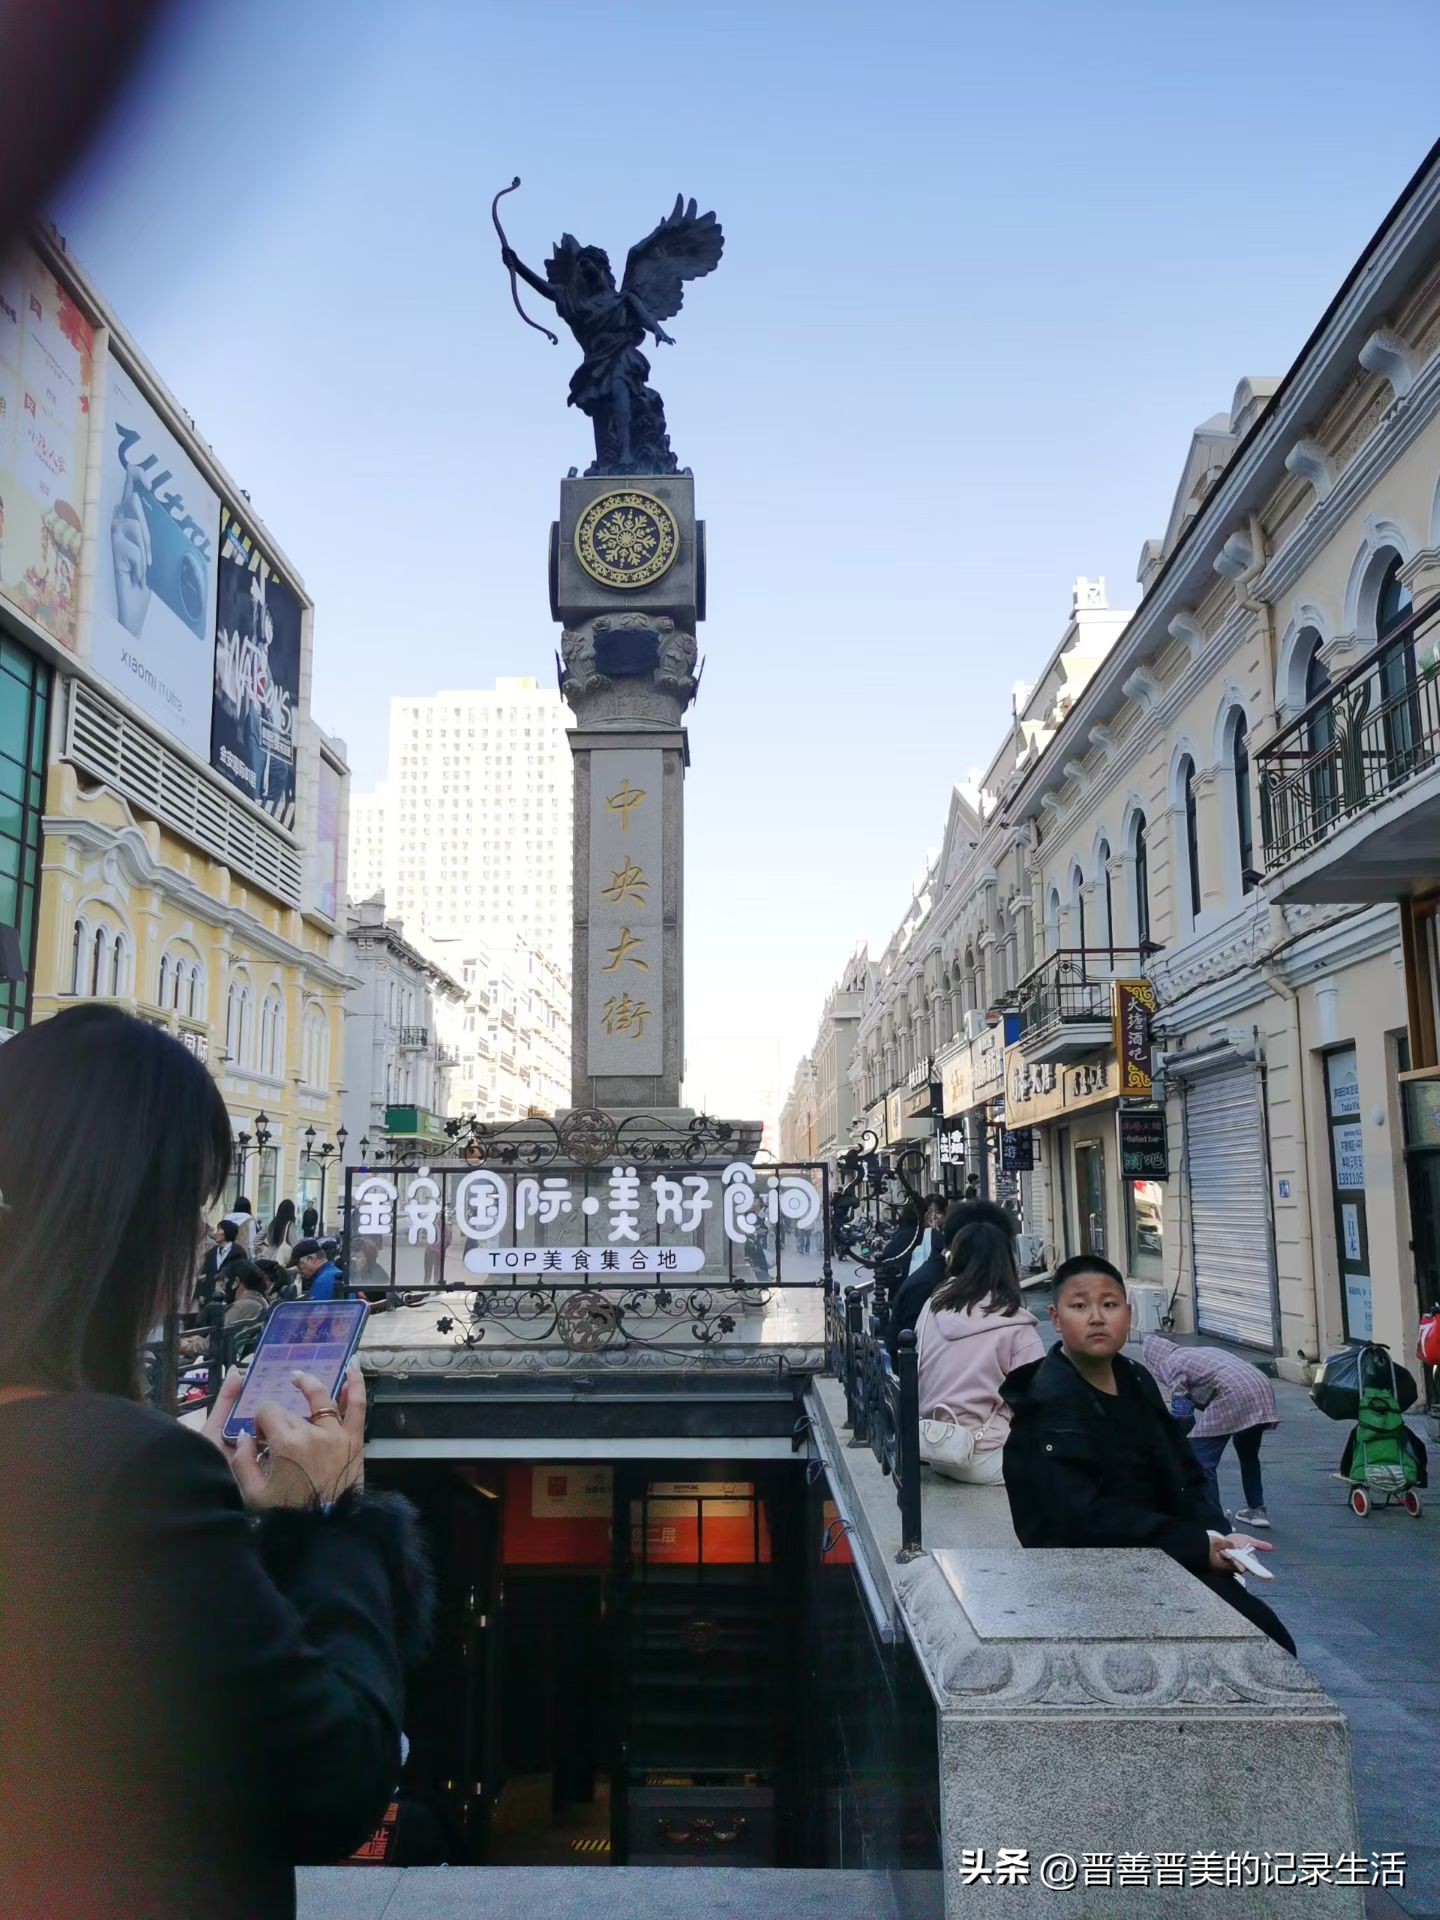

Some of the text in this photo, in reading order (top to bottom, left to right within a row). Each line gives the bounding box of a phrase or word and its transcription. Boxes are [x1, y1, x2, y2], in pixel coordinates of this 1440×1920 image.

[601, 779, 651, 1040] 中央大街
[1127, 996, 1148, 1061] 火塘酒吧
[489, 1249, 677, 1271] TOP美食集合地
